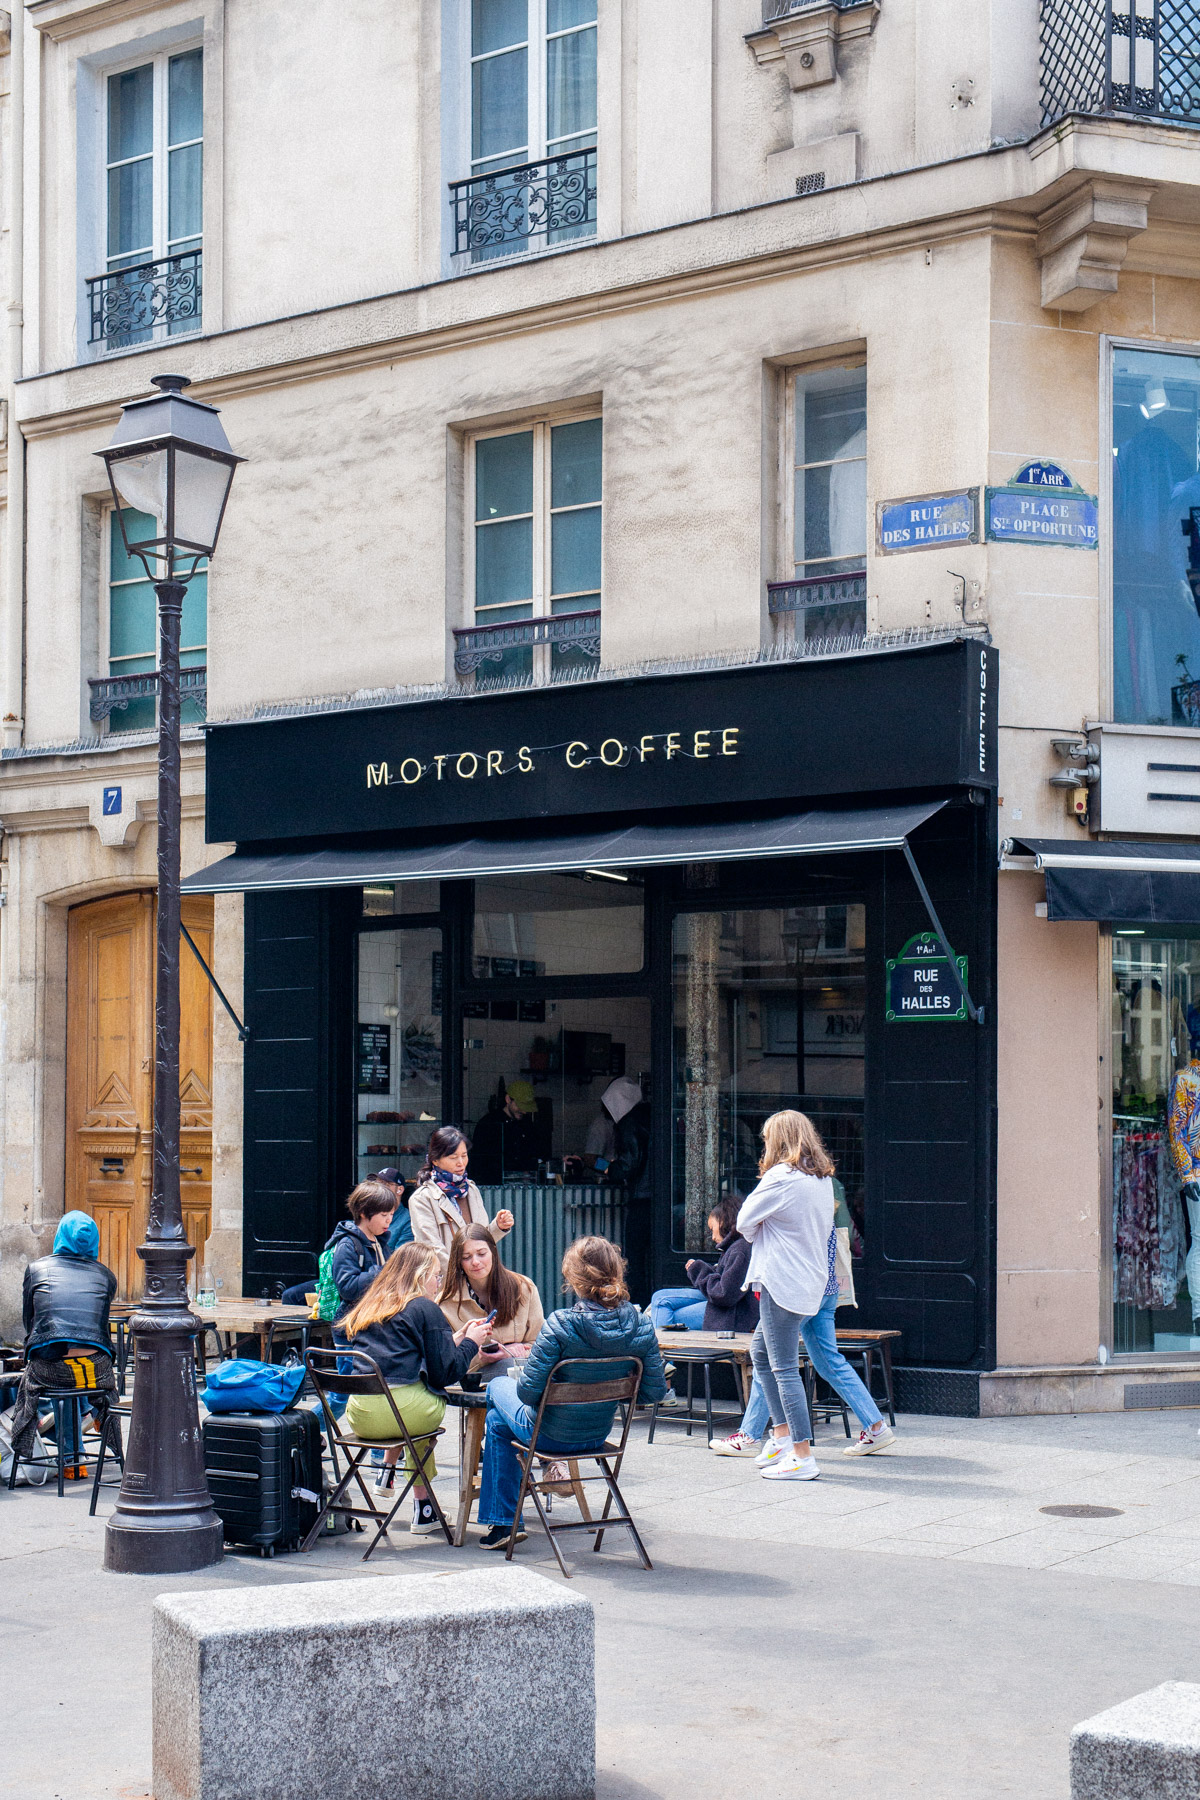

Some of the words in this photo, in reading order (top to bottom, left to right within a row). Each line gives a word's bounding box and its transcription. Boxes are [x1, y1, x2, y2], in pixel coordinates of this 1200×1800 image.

[910, 506, 942, 522] RUE
[1020, 501, 1069, 517] PLACE
[883, 528, 911, 544] DES
[915, 520, 970, 540] HALLES
[1013, 518, 1096, 538] OPPORTUNE
[366, 746, 533, 788] MOTORS
[565, 728, 739, 769] COFFEE
[107, 790, 118, 812] 7
[913, 969, 939, 983] RUE
[919, 985, 933, 993] DES
[901, 995, 951, 1010] HALLES
